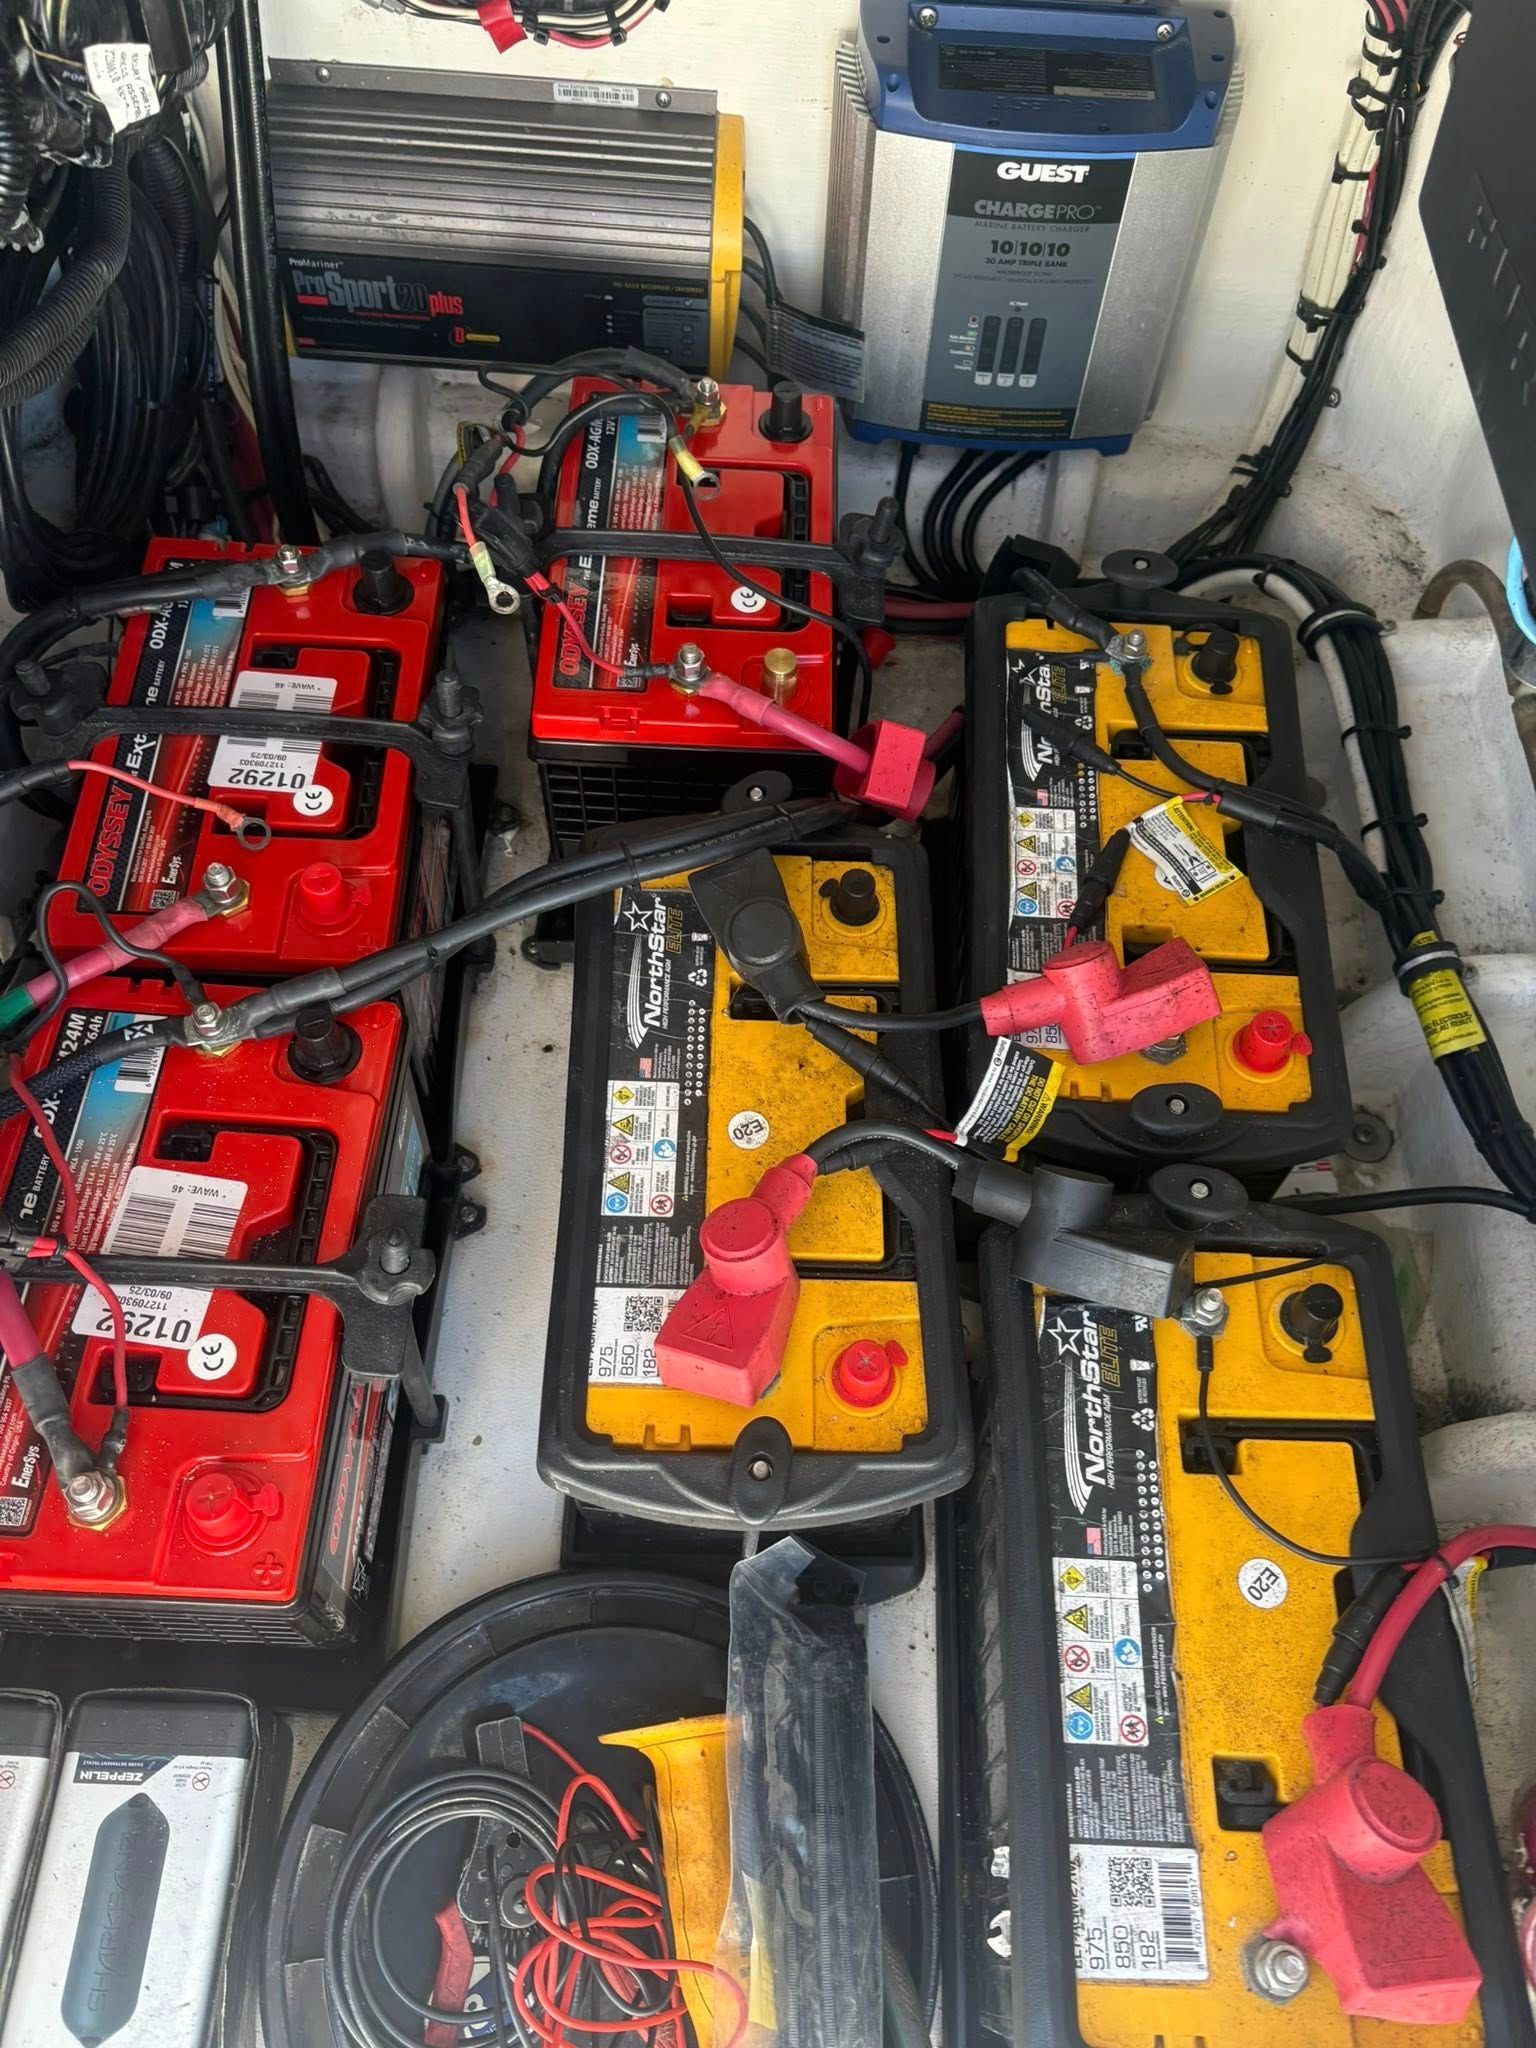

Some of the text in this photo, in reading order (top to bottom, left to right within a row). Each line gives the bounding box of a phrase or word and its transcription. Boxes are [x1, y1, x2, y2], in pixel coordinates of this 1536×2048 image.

[997, 161, 1090, 183] GUEST
[975, 221, 1090, 233] MARINE BATTERY CHARGER
[998, 258, 1016, 266] AMP
[1018, 259, 1042, 268] TRIPLE
[1044, 260, 1068, 268] BANK
[428, 291, 464, 317] plus
[592, 477, 602, 499] BATTERY
[153, 658, 166, 685] BATTERY
[1051, 664, 1066, 703] ELITE
[275, 681, 315, 691] WAVE: 46
[239, 759, 284, 769] 112709303
[251, 752, 287, 761] 09/03/25
[228, 768, 307, 790] 01292
[85, 782, 134, 898] ODYSSEY
[161, 853, 183, 885] EnerSys
[666, 906, 682, 954] ELITE
[644, 896, 667, 1027] NorthStar
[662, 972, 671, 1012] PERFORMANCE
[1030, 1086, 1043, 1100] NOT
[1035, 1076, 1046, 1087] DO
[996, 1073, 1039, 1143] THE DC BATTERY CABLES
[1021, 1111, 1031, 1122] OR
[1025, 1099, 1037, 1113] CUT
[1026, 1101, 1048, 1135] WARNING
[732, 1119, 763, 1139] E20
[74, 1137, 85, 1154] 1500
[76, 1158, 90, 1183] minutes
[91, 1151, 102, 1168] 14.8V
[102, 1153, 112, 1170] 13.8V
[109, 1162, 120, 1178] Limit
[31, 1153, 51, 1192] BATTERY
[86, 1171, 96, 1185] 14.4
[97, 1173, 106, 1187] 13.5
[78, 1184, 93, 1212] Voltage:
[88, 1186, 103, 1213] Voltage:
[103, 1178, 116, 1201] Current
[170, 1183, 219, 1198] WAVE: 46
[72, 1210, 86, 1233] Charge
[83, 1212, 96, 1234] Charge
[78, 1234, 88, 1251] Float
[128, 1285, 173, 1299] 09/03/25
[94, 1306, 191, 1344] 01292
[597, 1345, 613, 1377] 975
[619, 1344, 635, 1376] 850
[642, 1347, 657, 1377] 182
[1099, 1323, 1120, 1387] ELITE
[1078, 1310, 1105, 1485] NorthStar
[0, 1461, 13, 1487] Country
[8, 1433, 21, 1455] Origin:
[15, 1419, 24, 1433] USA
[1104, 1413, 1114, 1468] PERFORMANCE
[10, 1442, 42, 1490] EnerSys
[1247, 1565, 1280, 1600] E20
[79, 1769, 143, 1781] ZEPPELIN
[1086, 1926, 1104, 1970] 975
[1112, 1924, 1130, 1968] 850
[1138, 1929, 1156, 1969] 182
